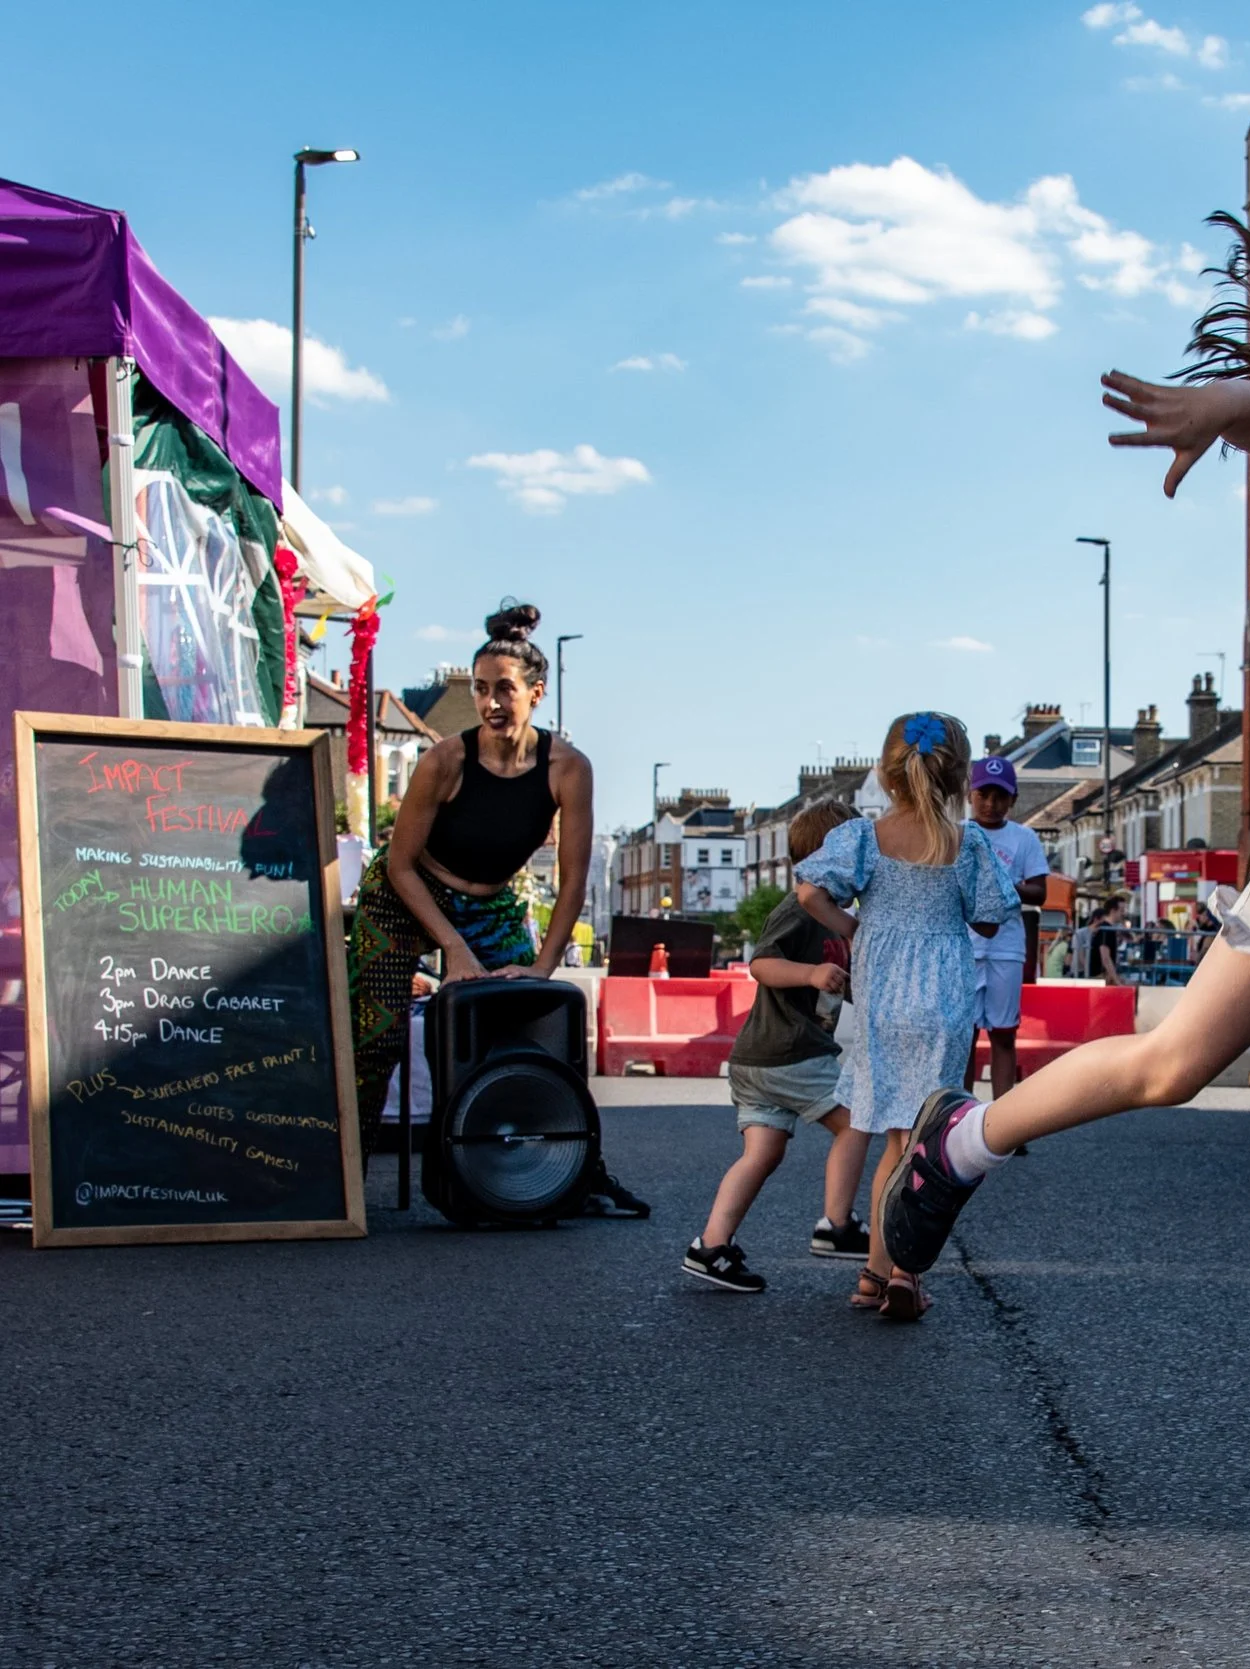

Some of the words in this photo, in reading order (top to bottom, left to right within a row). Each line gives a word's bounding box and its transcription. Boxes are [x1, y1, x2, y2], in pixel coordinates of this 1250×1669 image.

[78, 751, 193, 794] IMPACT
[145, 793, 277, 836] FESTIVAL
[75, 847, 132, 865] MAKING
[140, 853, 246, 873] SUSTAINABILITY
[255, 861, 294, 880] FUN!
[54, 869, 104, 912] TODAY
[130, 879, 232, 905] HUMAN
[119, 902, 294, 935] SUPERHERO
[100, 955, 136, 987] 2pm
[150, 957, 212, 981] DANCE
[100, 987, 135, 1018] 3pm
[143, 987, 194, 1010] DRAG
[203, 987, 285, 1012] CABARET
[159, 1018, 223, 1044] DANCE
[66, 1067, 117, 1103] PLUS
[147, 1071, 219, 1101] SUPERHERO
[224, 1060, 256, 1082] FACE
[121, 1110, 239, 1152] SUSTAINABILITY
